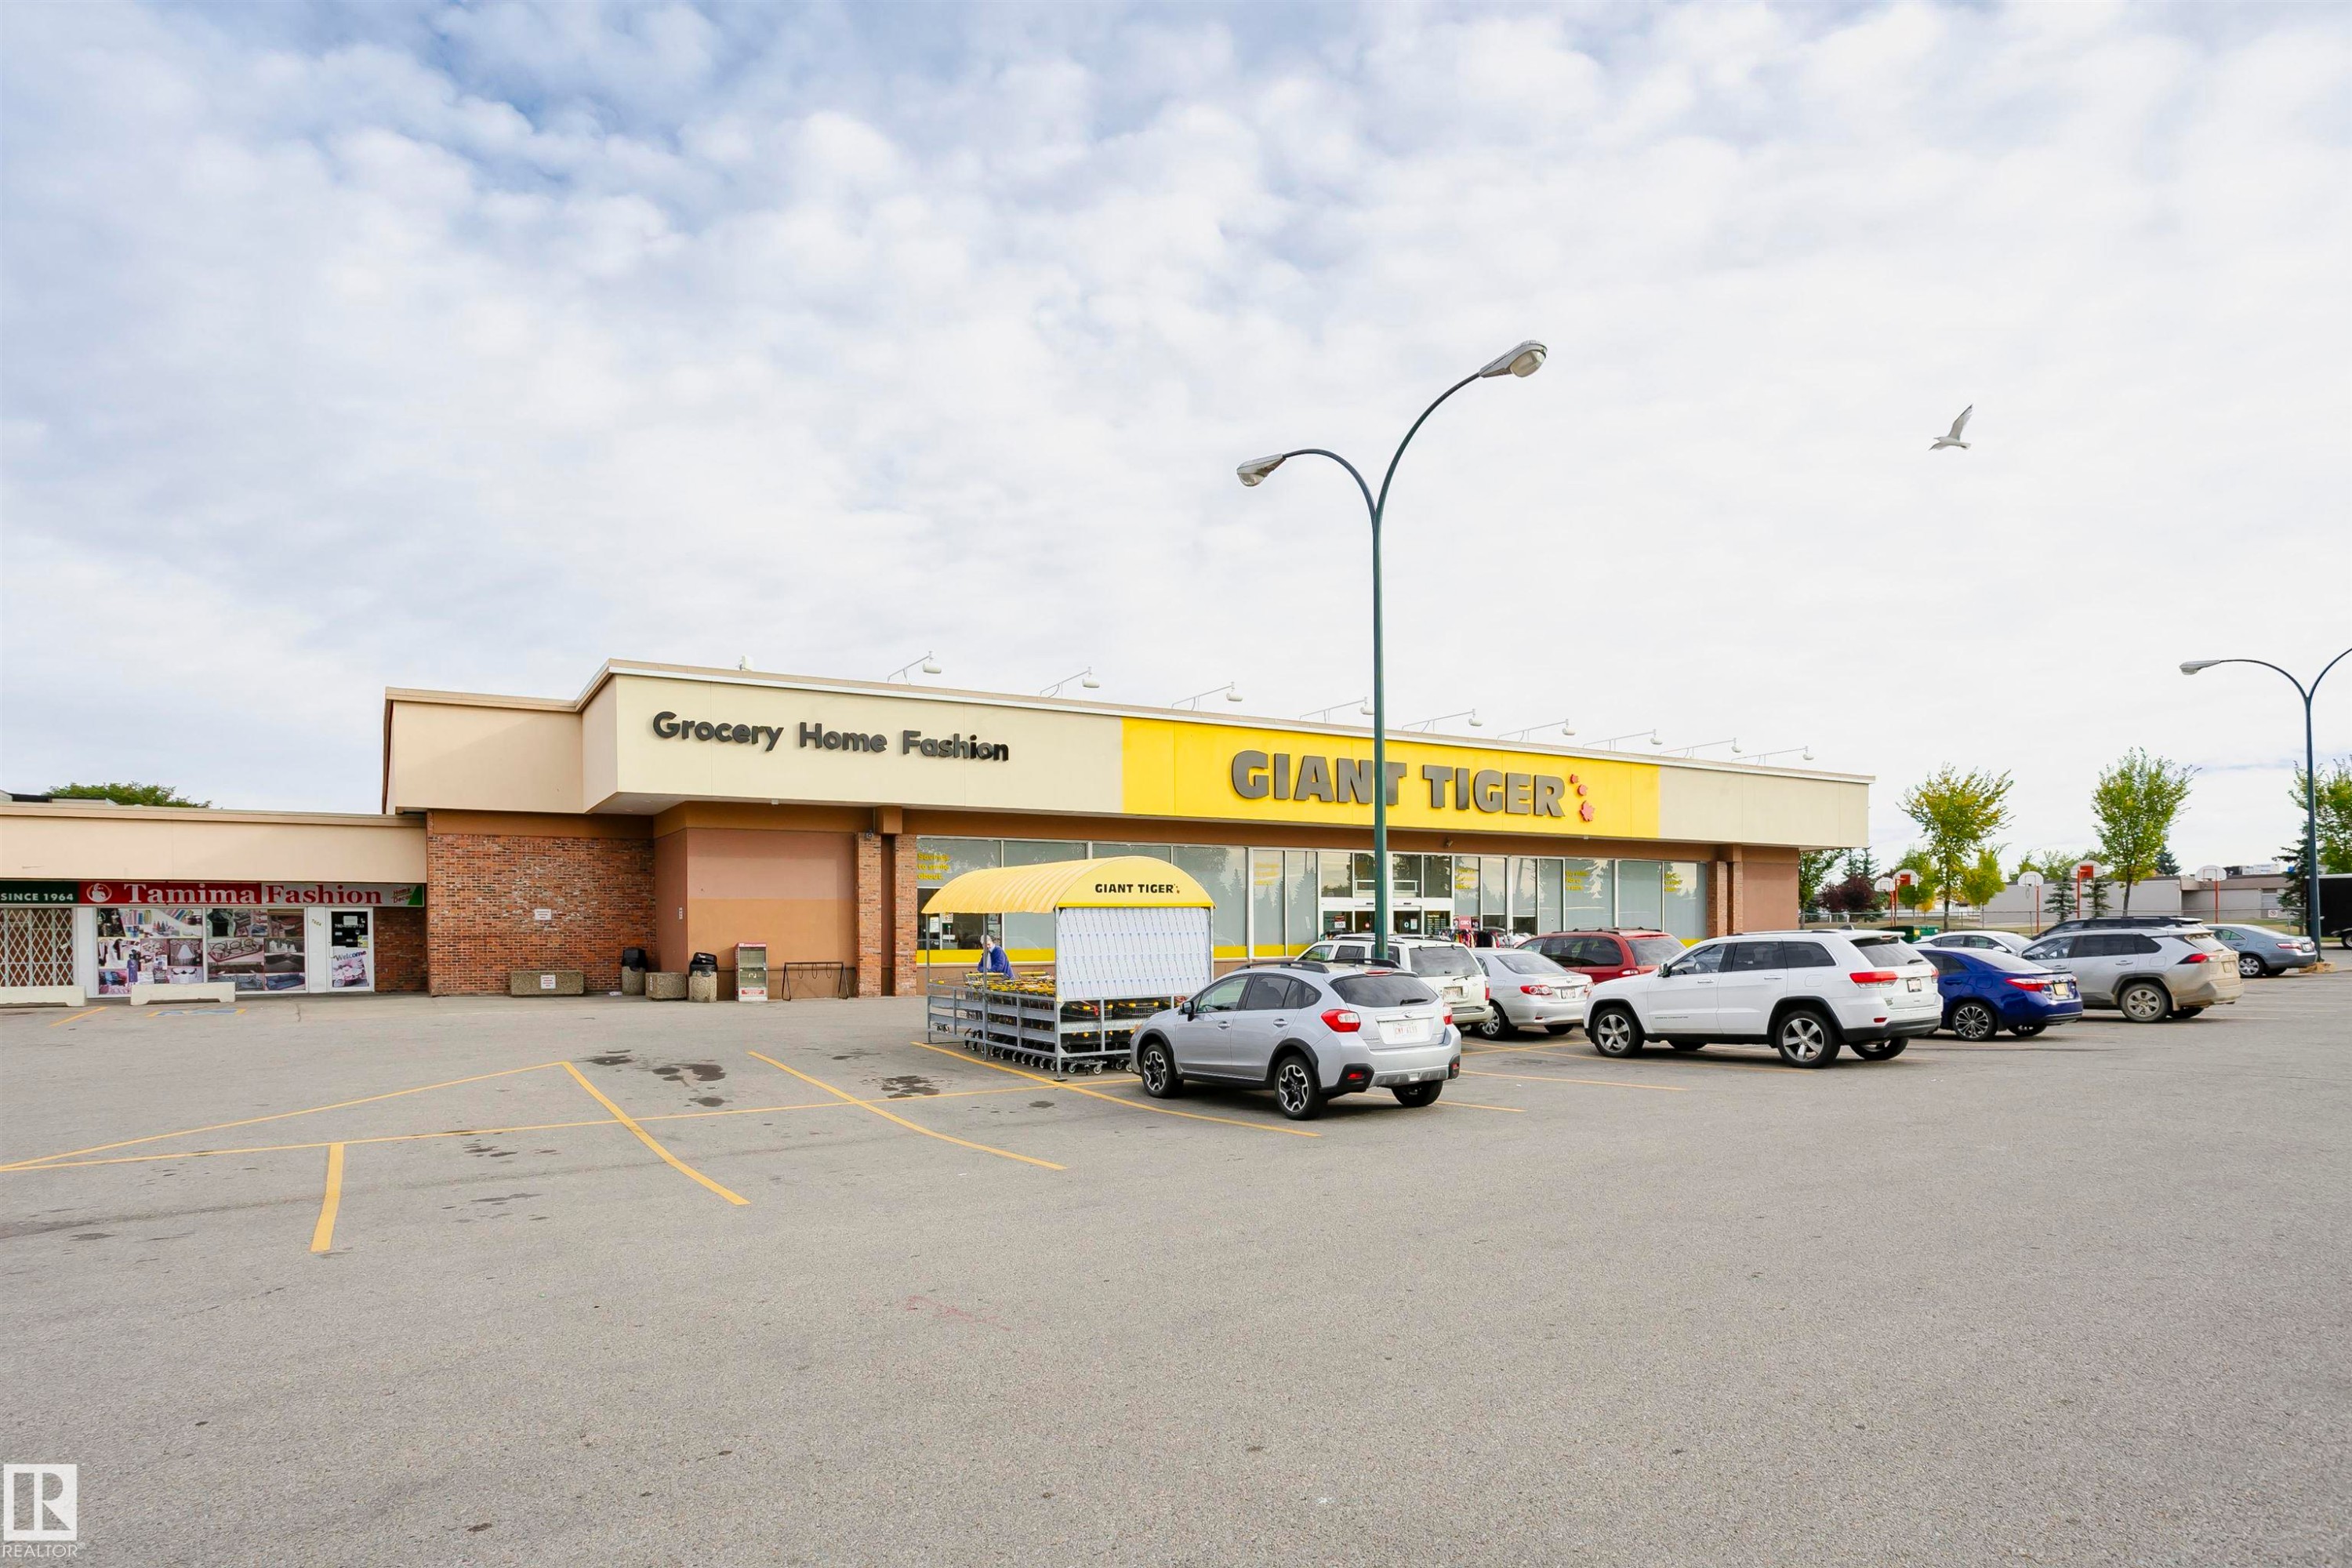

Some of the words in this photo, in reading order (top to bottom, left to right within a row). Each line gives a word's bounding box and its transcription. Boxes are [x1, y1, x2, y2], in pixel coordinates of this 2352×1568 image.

[652, 710, 784, 751] Grocery
[799, 721, 887, 753] Home
[902, 730, 1010, 761] Fashion
[1231, 750, 1407, 805] GIANT
[1422, 764, 1566, 817] TIGER
[124, 883, 257, 903] Tamima
[265, 884, 383, 904] Fashion
[1094, 884, 1134, 893] GIANT
[1138, 884, 1174, 894] TIGER
[333, 950, 367, 961] Welcome
